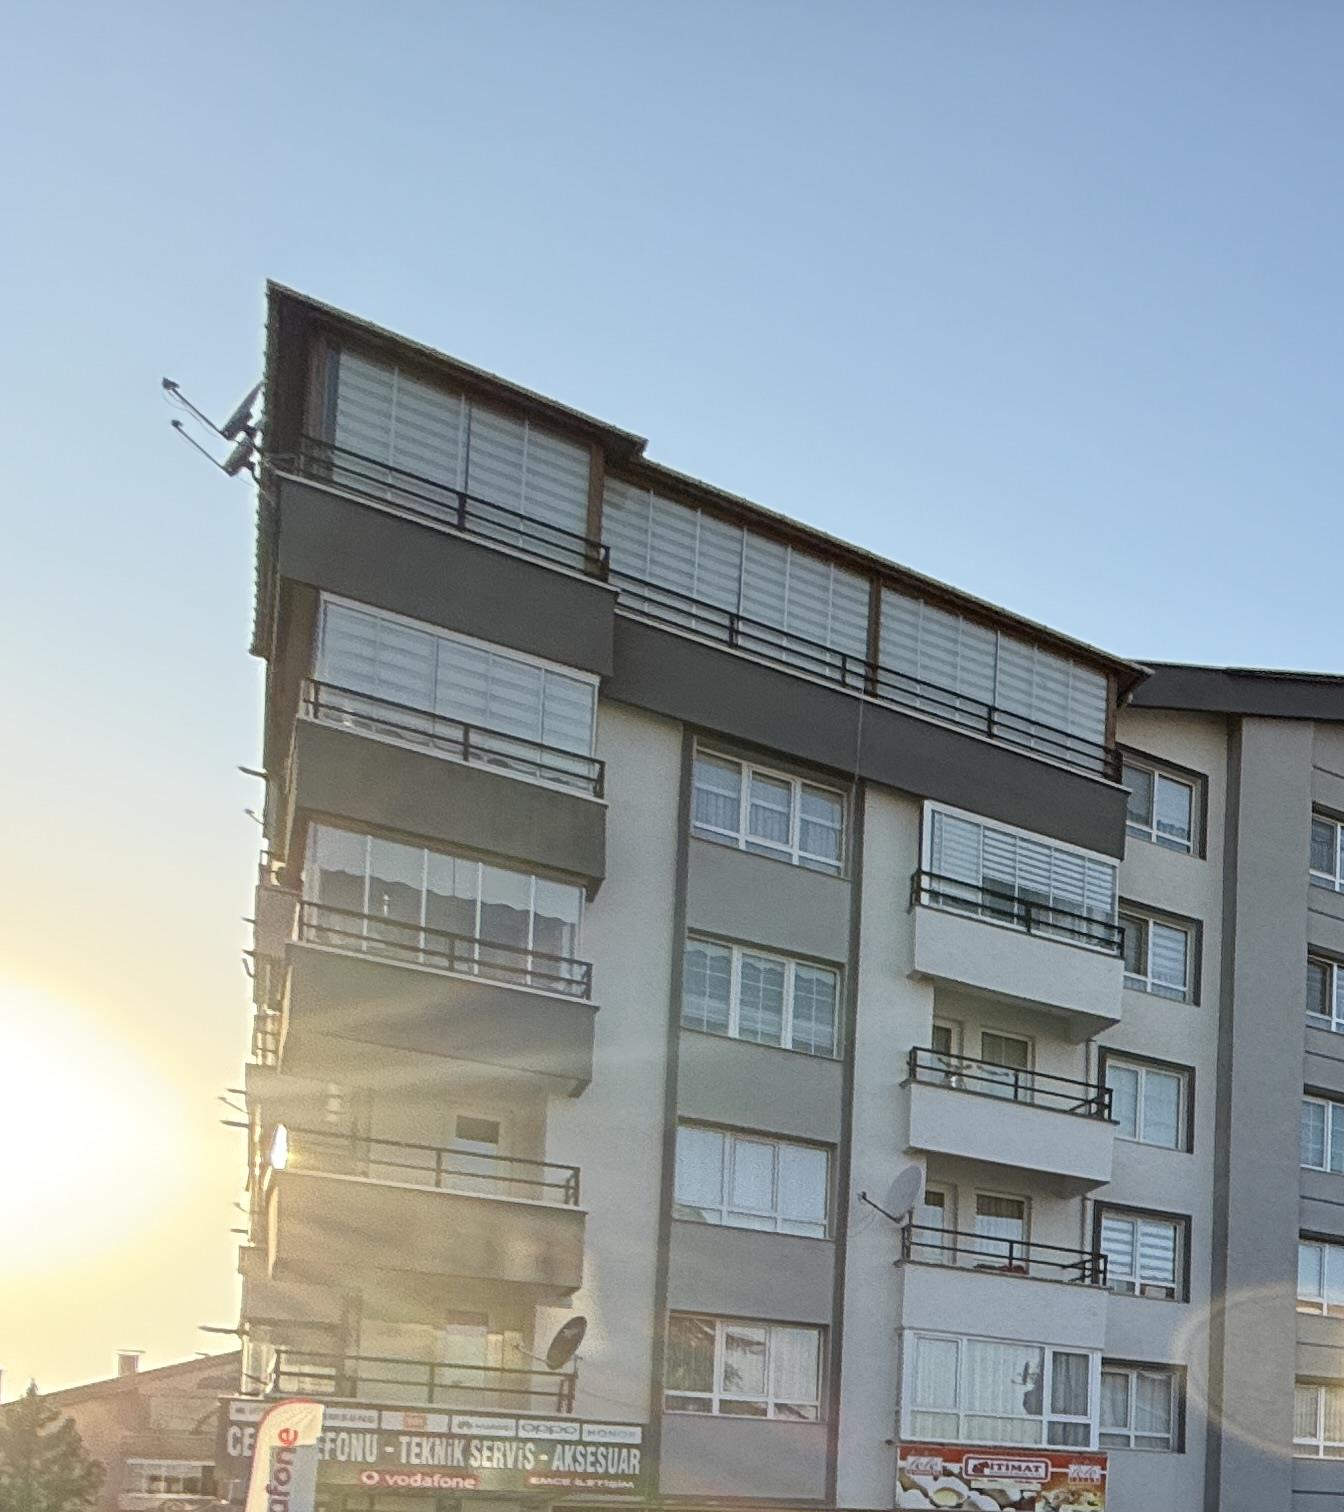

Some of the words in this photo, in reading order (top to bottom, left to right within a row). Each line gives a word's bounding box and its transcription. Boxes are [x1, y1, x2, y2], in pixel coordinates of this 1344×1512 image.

[226, 1425, 256, 1457] CE
[551, 1445, 641, 1475] AKSESUAR
[384, 1473, 477, 1490] vodafone
